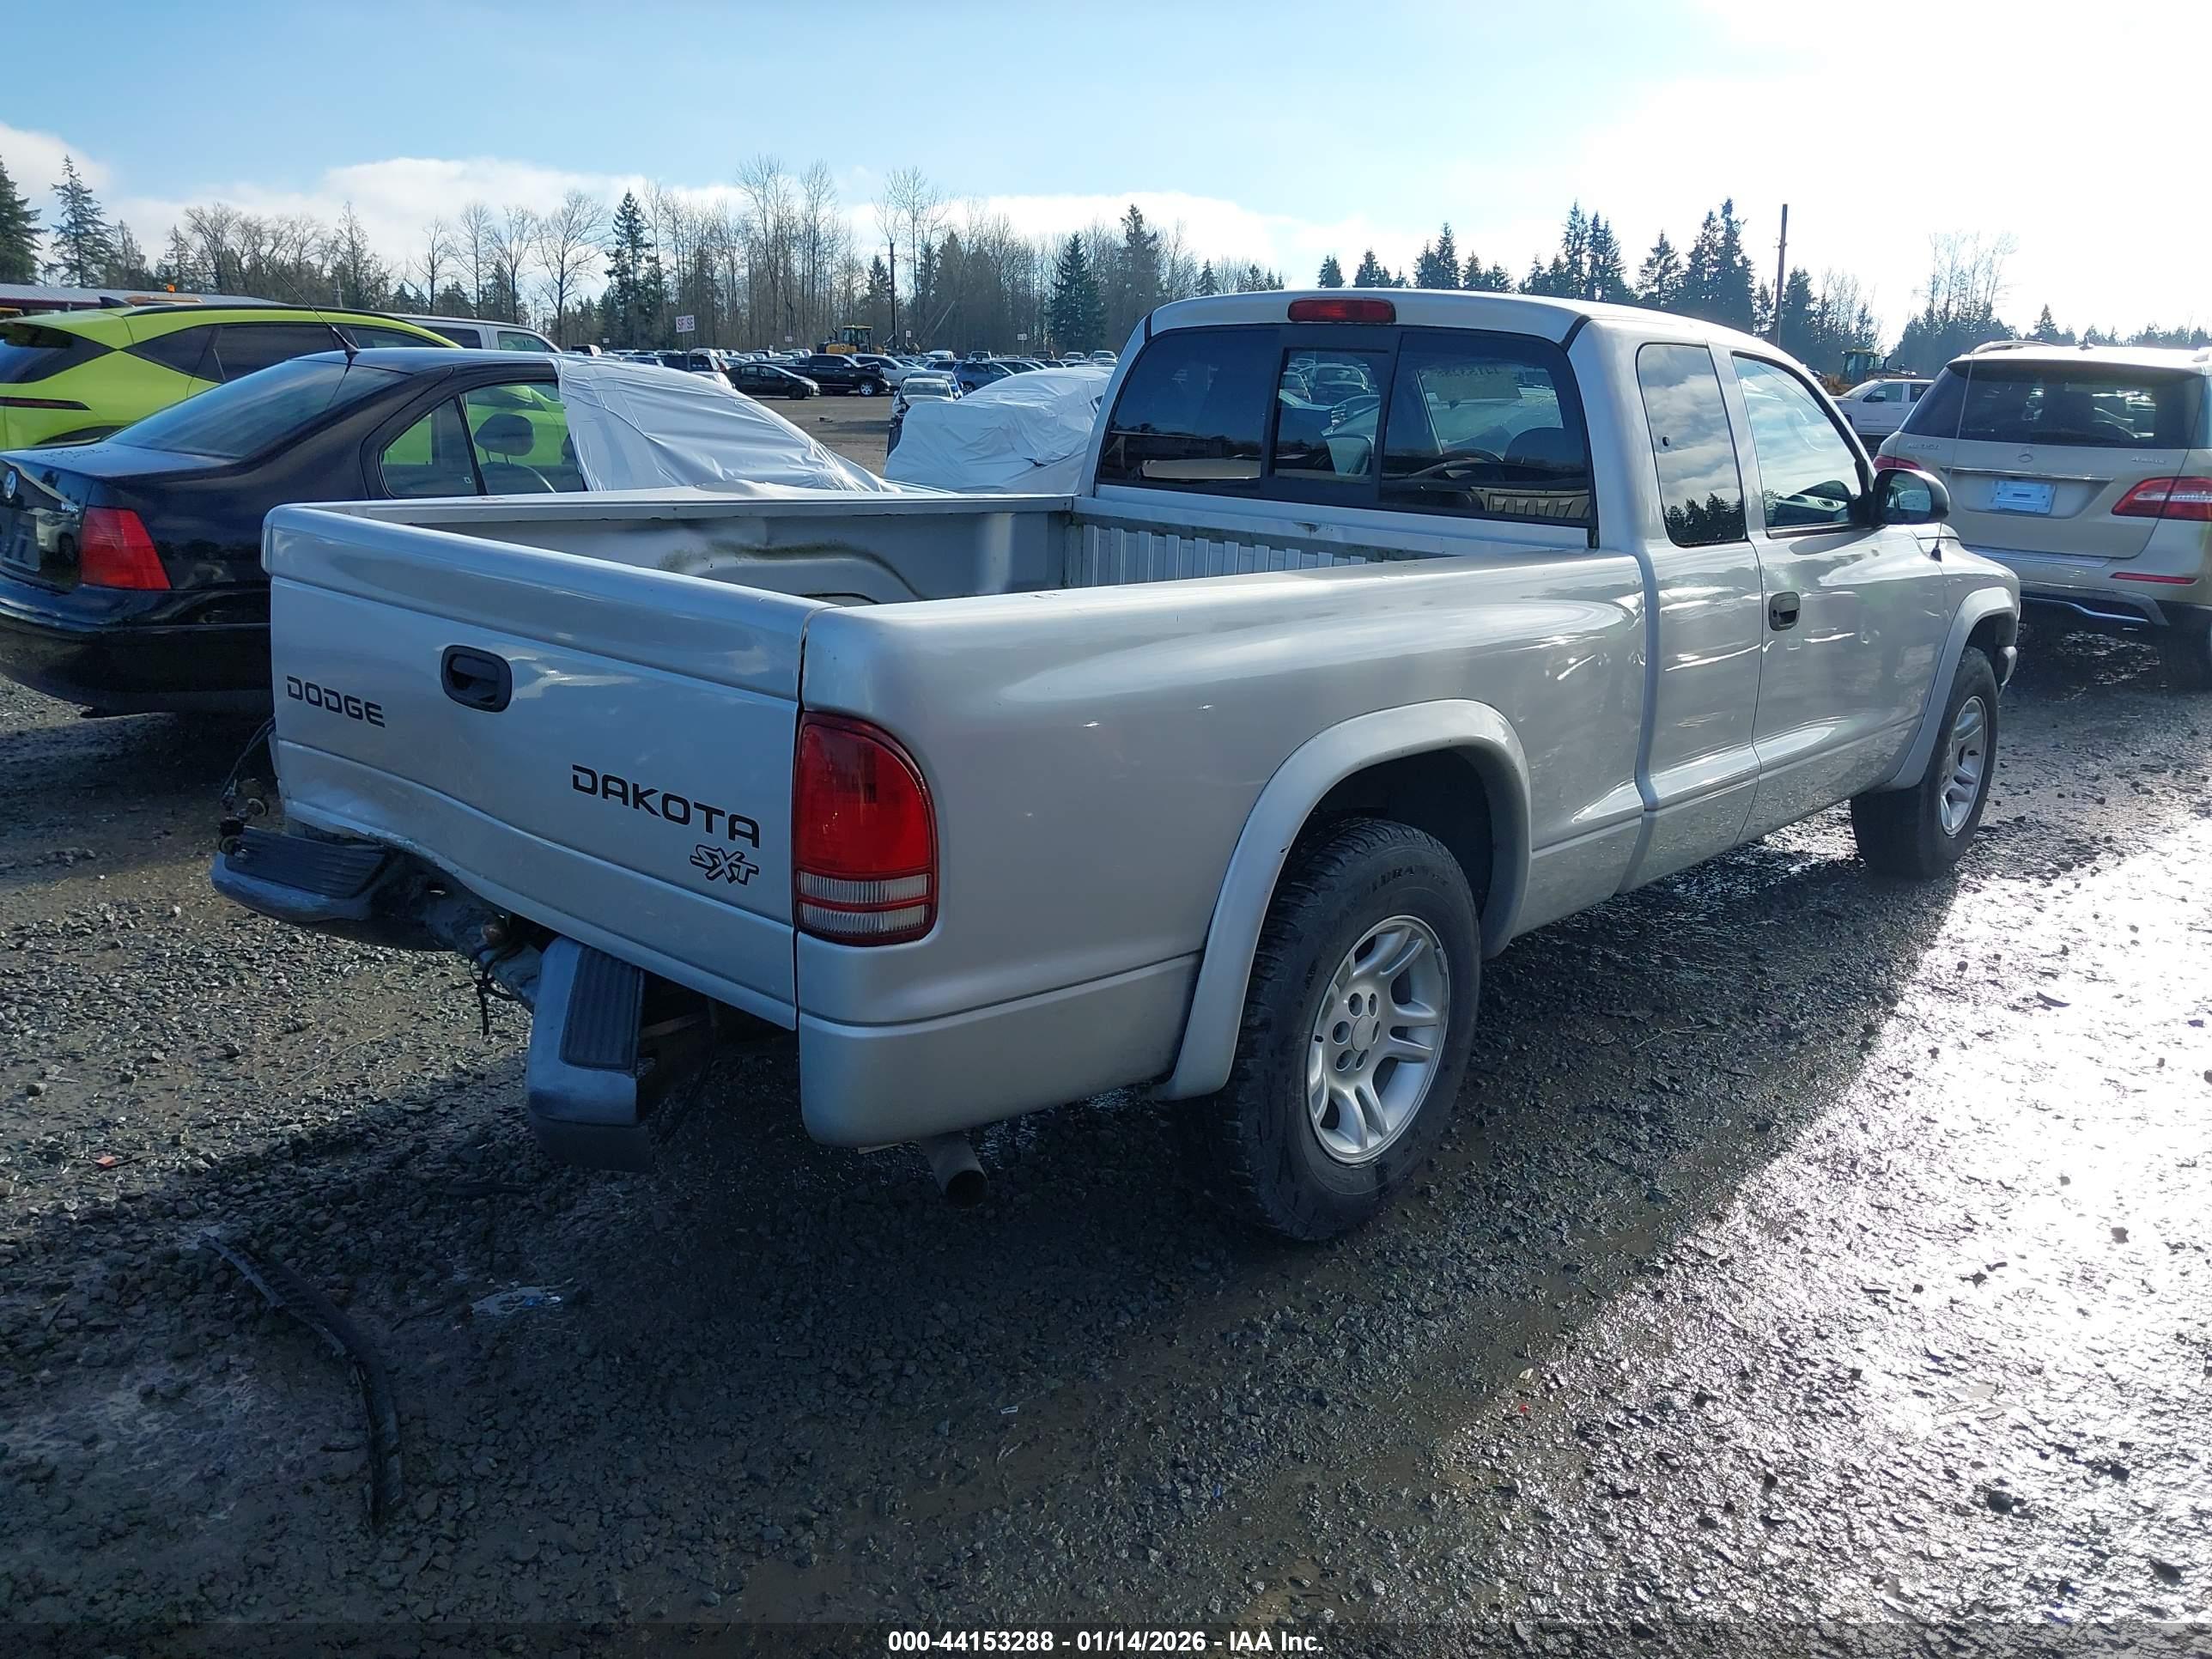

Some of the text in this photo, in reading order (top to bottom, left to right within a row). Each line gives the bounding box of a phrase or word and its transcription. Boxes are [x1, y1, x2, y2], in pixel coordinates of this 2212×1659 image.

[287, 675, 386, 729] DODGE
[572, 764, 761, 848] DAKOTA
[690, 844, 760, 885] SXT
